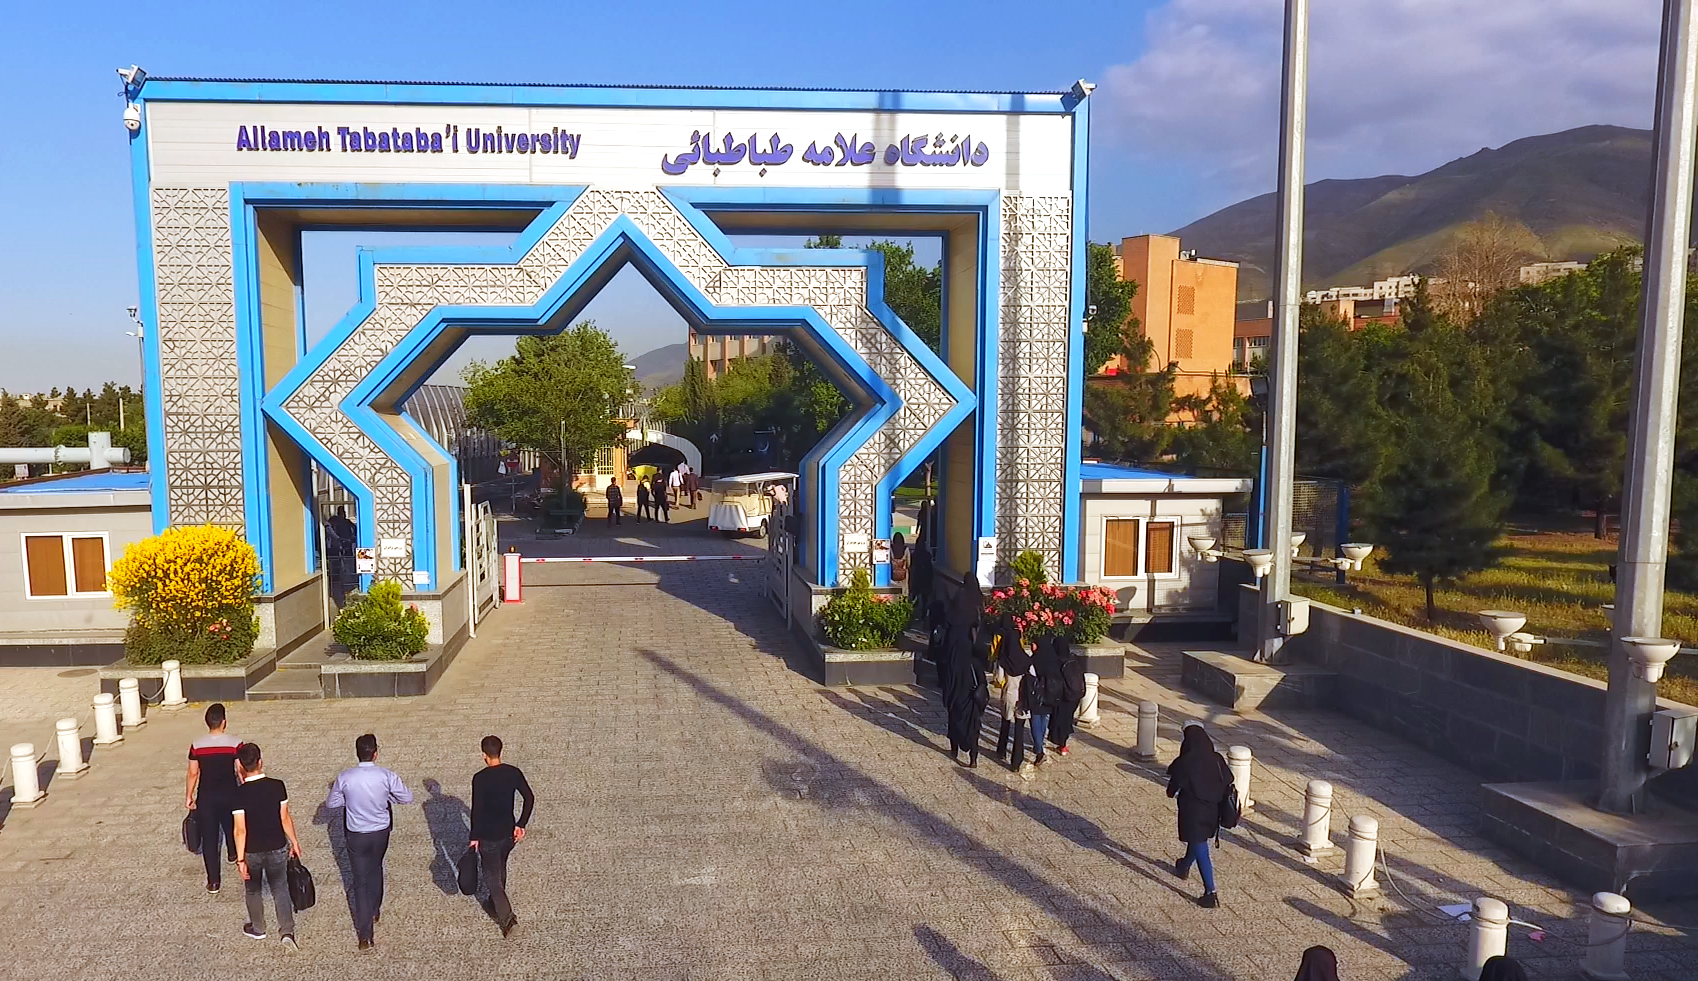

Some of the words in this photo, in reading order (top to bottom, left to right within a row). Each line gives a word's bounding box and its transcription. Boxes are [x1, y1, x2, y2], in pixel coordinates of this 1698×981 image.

[236, 125, 331, 152] Allameh
[337, 124, 458, 153] Tabataba'i
[466, 126, 582, 160] University
[662, 130, 794, 178] طباطبائی
[801, 132, 876, 167] علامه
[883, 132, 989, 167] دانشگاه
